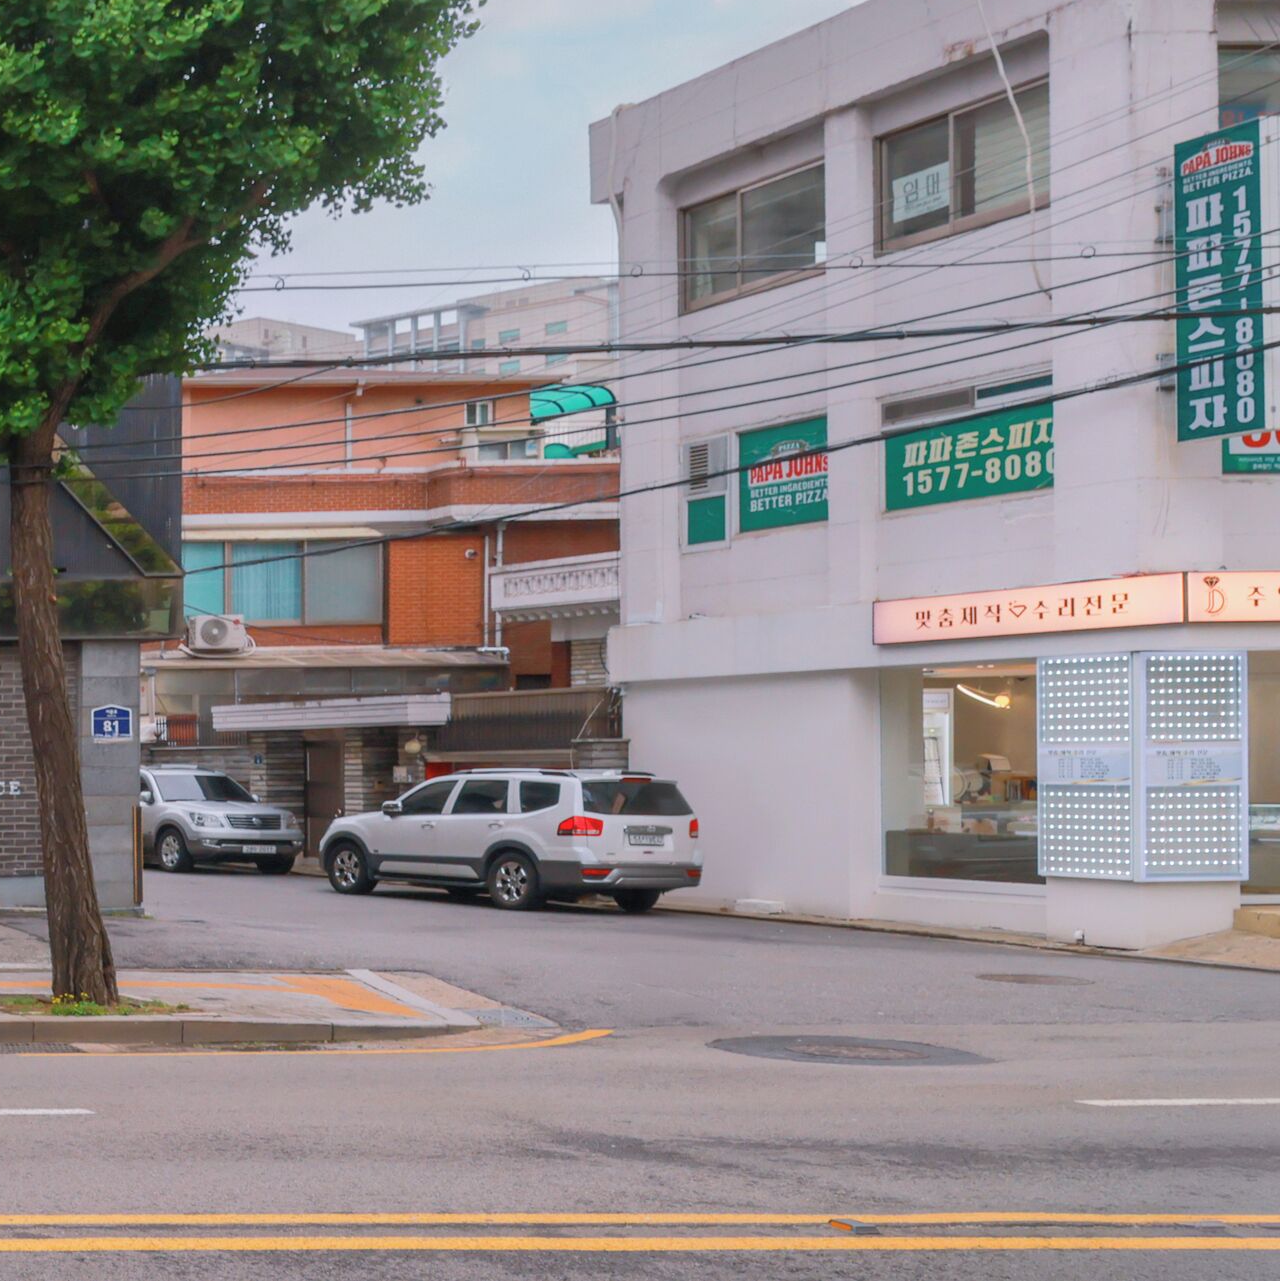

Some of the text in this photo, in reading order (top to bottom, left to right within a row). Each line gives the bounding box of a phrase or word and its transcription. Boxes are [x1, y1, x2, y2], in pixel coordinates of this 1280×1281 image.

[1183, 151, 1212, 176] PAPA
[1183, 176, 1220, 194] BETTER
[1186, 192, 1227, 431] 파파존스피자
[1232, 185, 1255, 423] 1577-8080
[750, 461, 782, 484] PAPA
[750, 494, 792, 512] BETTER
[1031, 591, 1130, 620] 수리전문
